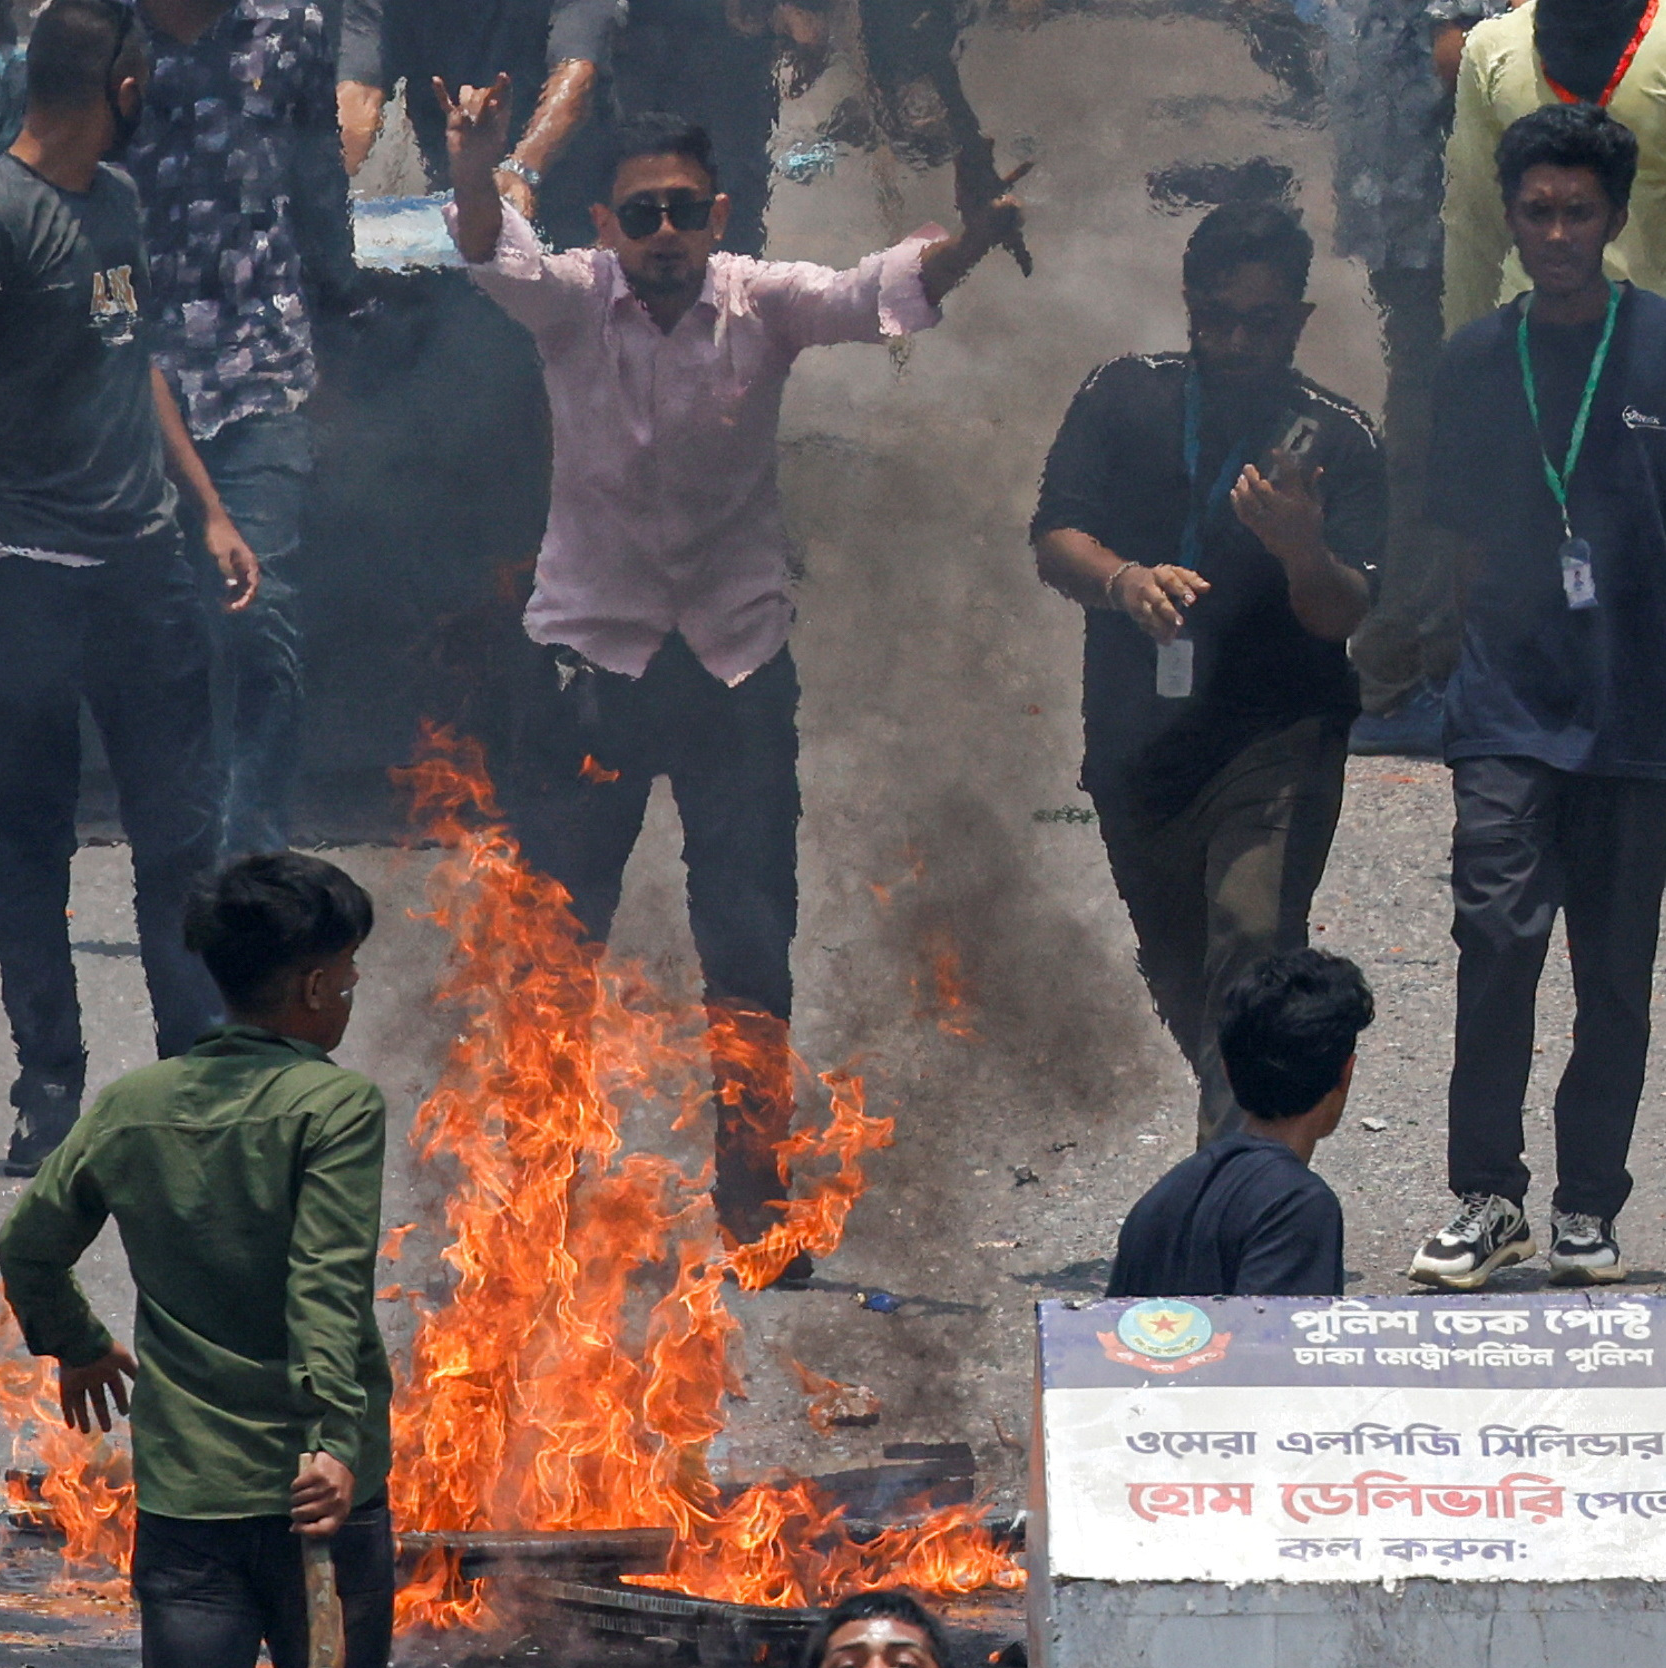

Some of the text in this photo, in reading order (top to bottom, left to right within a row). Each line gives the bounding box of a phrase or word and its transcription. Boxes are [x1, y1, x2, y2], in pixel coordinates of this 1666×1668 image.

[1291, 1299, 1653, 1342] পুলিশ চেক পোস্ট
[1293, 1342, 1654, 1372] ঢাকা মেট্রোপলিটন পুলিশ
[1126, 1422, 1665, 1462] ওমেরা এলপিজি সিলিন্ডার
[1126, 1481, 1255, 1523] হোম
[1277, 1471, 1567, 1525] ডেলিভারি
[1276, 1537, 1363, 1563] কল
